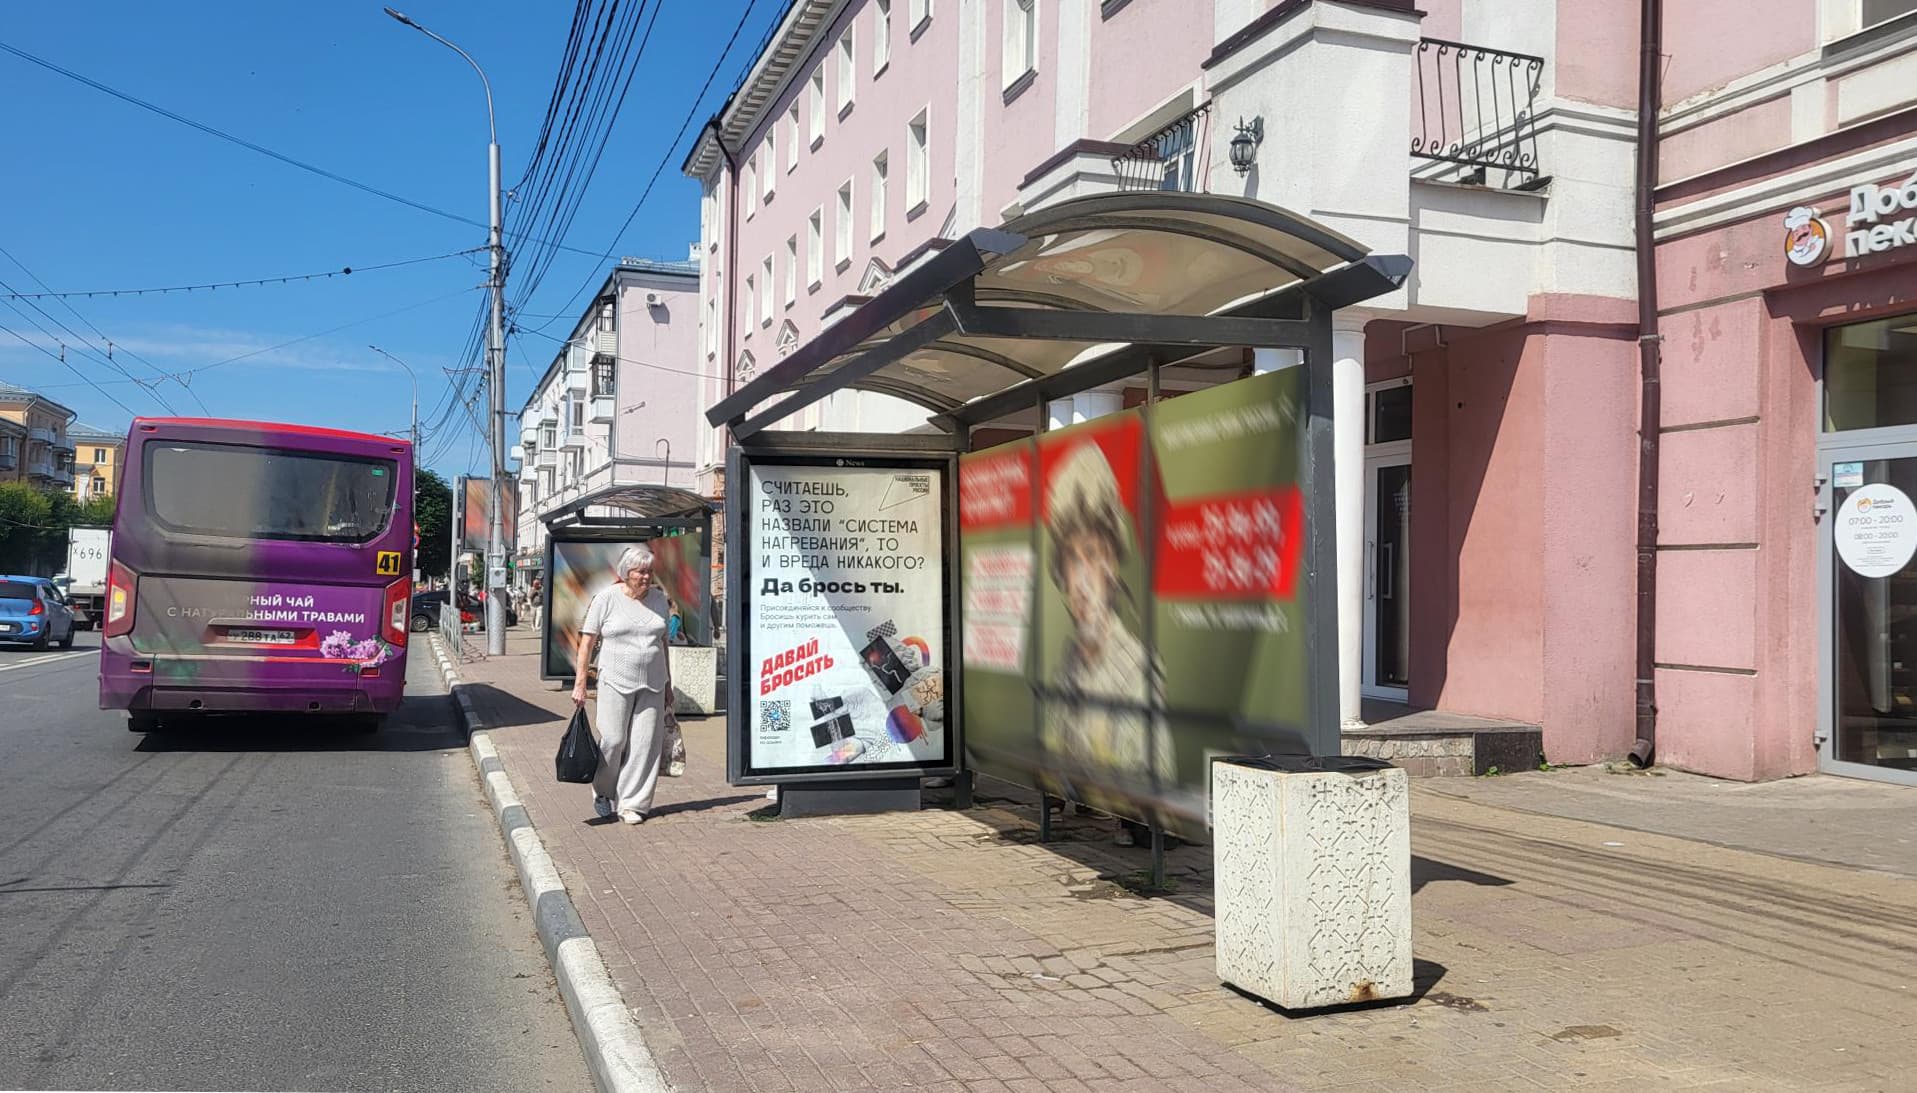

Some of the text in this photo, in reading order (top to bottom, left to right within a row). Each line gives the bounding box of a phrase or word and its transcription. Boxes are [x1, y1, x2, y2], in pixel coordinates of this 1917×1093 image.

[1845, 217, 1917, 257] пек
[761, 481, 849, 497] СЧИТАЕШЬ,
[762, 501, 834, 514] РАЗ ЭТО
[762, 519, 831, 532] НАЗВАЛИ
[877, 539, 899, 551] ТО
[378, 554, 399, 573] 41
[762, 555, 925, 570] И ВРЕДА НИКАКОГО?
[761, 578, 905, 597] Да брось ты.
[245, 594, 314, 608] НЫЙ ЧАЙ
[167, 607, 176, 617] С
[302, 611, 365, 623] ТРАВАМИ
[796, 614, 821, 622] курить
[767, 622, 794, 630] другим
[761, 636, 819, 678] ДАВАЙ
[760, 654, 834, 696] БРОСАТЬ
